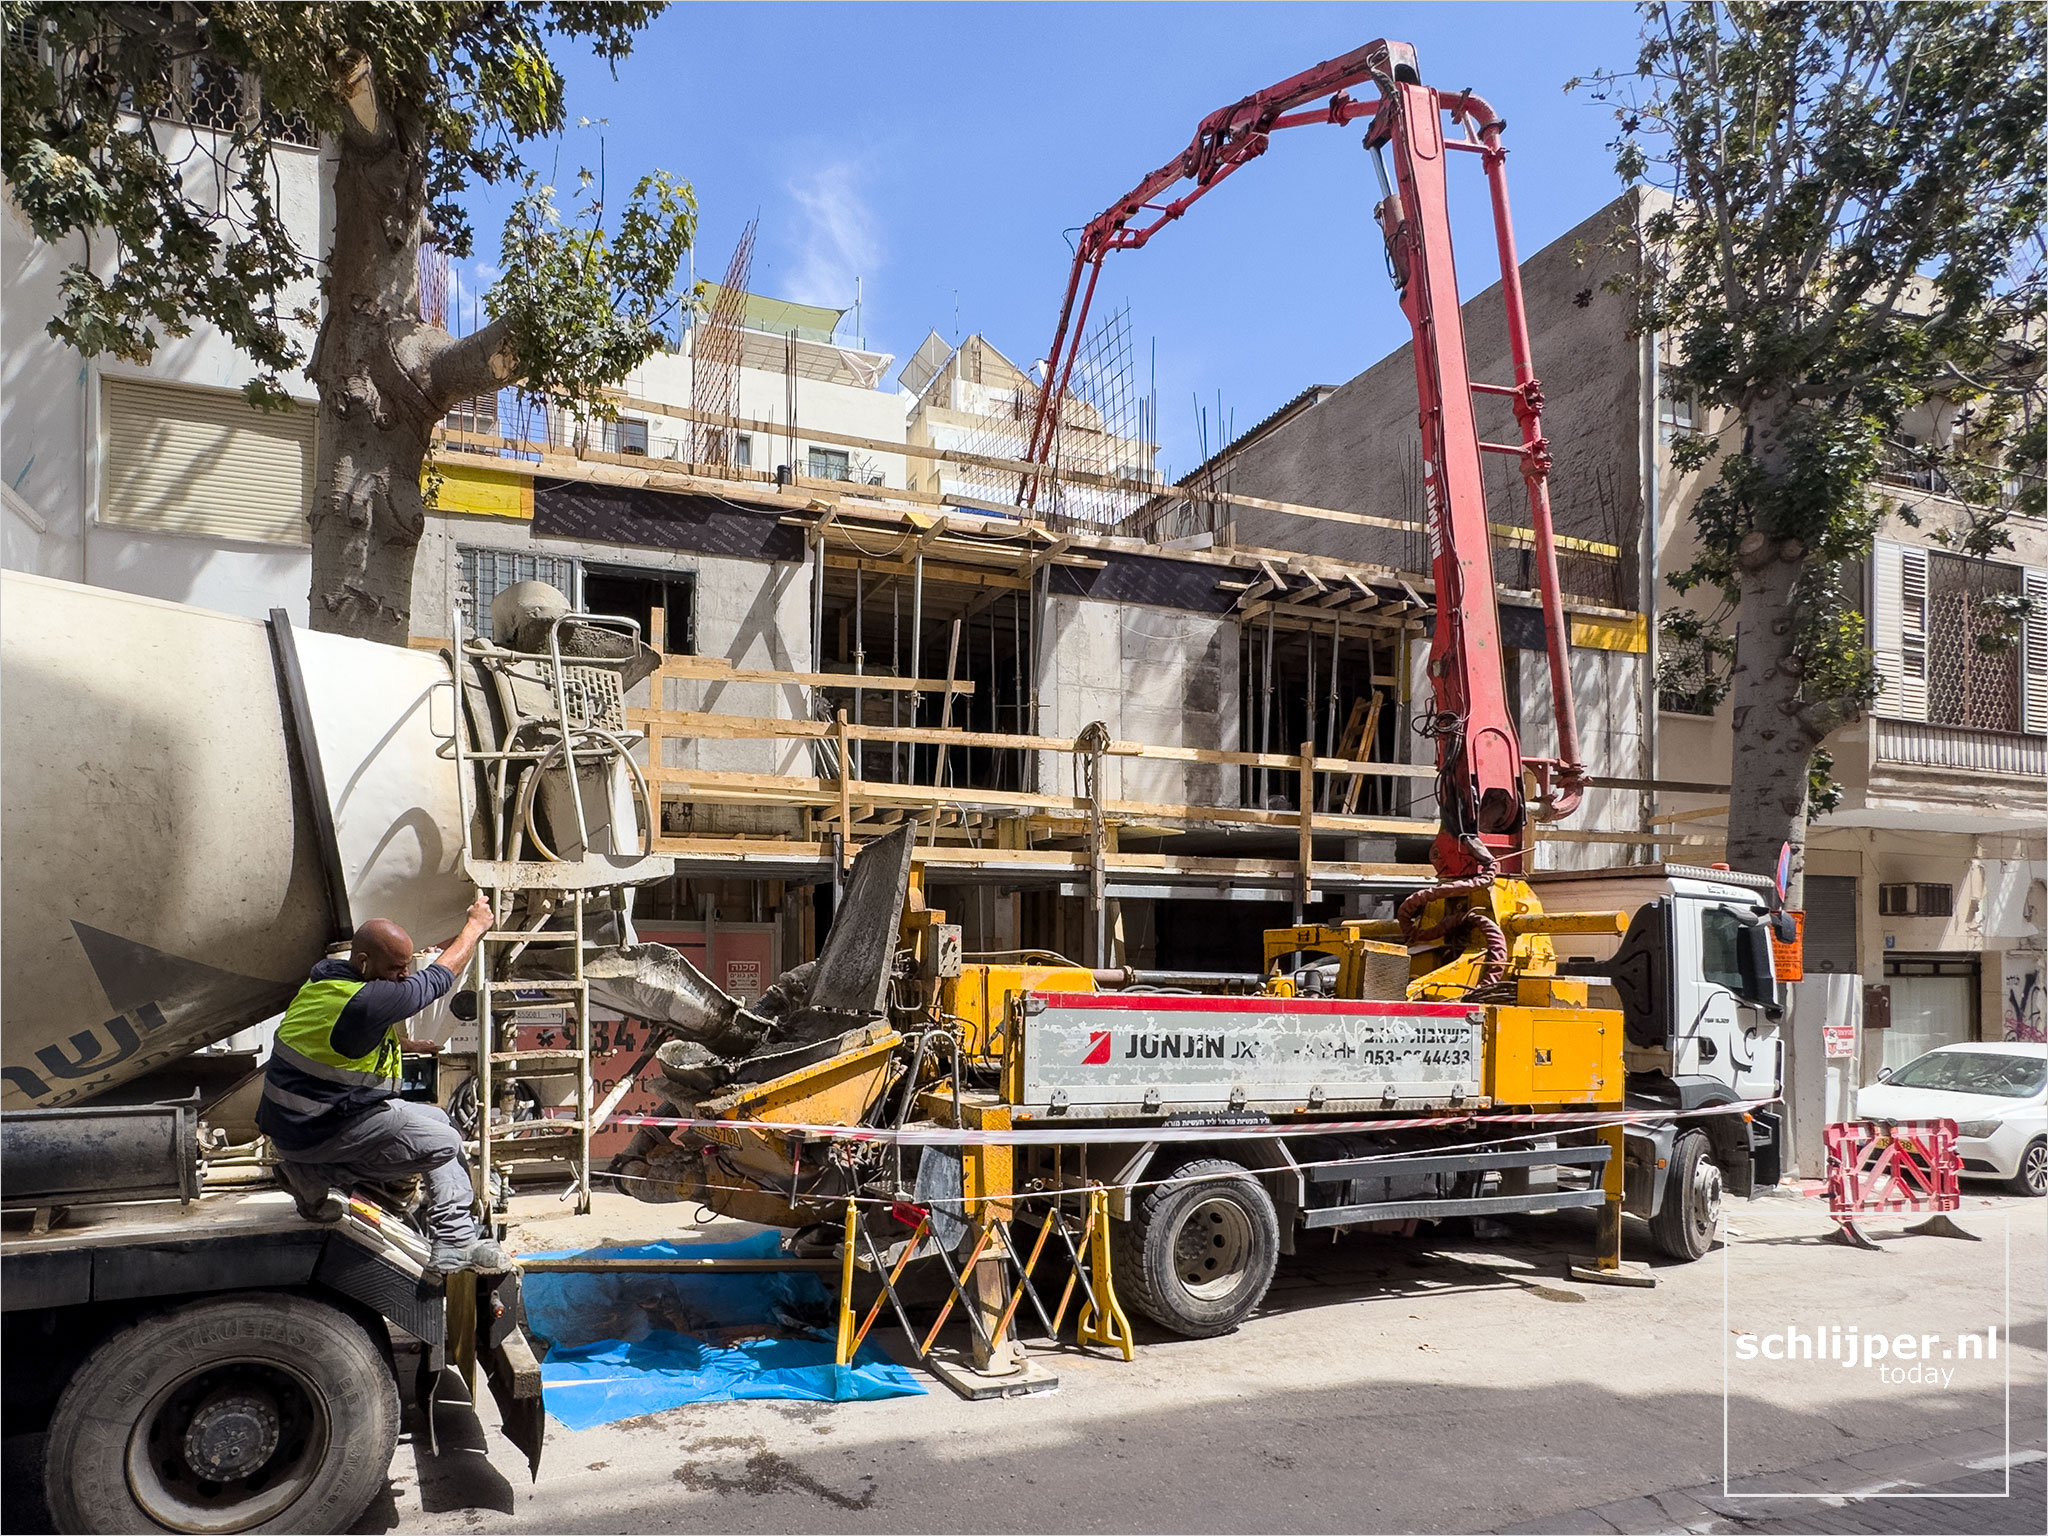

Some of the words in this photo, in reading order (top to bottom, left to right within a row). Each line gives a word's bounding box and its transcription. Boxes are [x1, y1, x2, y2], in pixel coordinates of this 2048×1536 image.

[1425, 484, 1442, 560] JUNJIN
[731, 964, 756, 972] סכנה
[1125, 1033, 1226, 1059] JUNJIN
